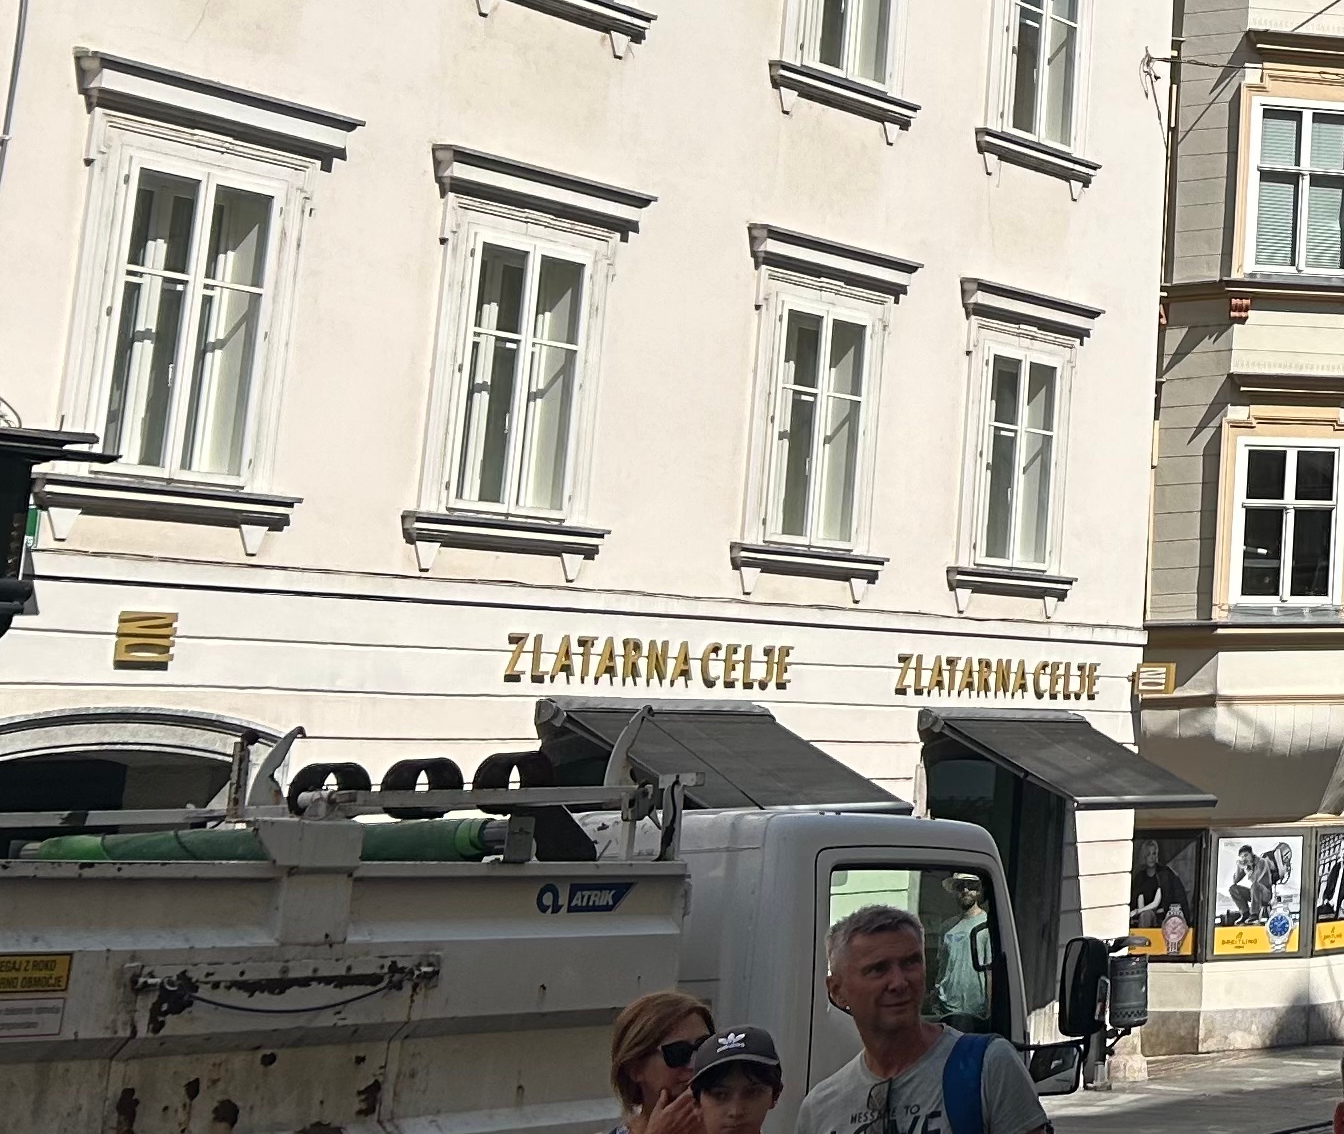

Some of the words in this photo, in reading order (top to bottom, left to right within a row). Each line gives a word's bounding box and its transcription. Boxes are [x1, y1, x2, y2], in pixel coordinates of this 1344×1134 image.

[504, 632, 692, 688] ZLATARNA
[700, 642, 794, 691] CELJE
[895, 653, 1028, 699] ZLATARNA
[1033, 660, 1101, 700] CELJE
[570, 889, 617, 906] ATRIK
[850, 1108, 897, 1125] MESSE
[904, 1103, 921, 1116] TO
